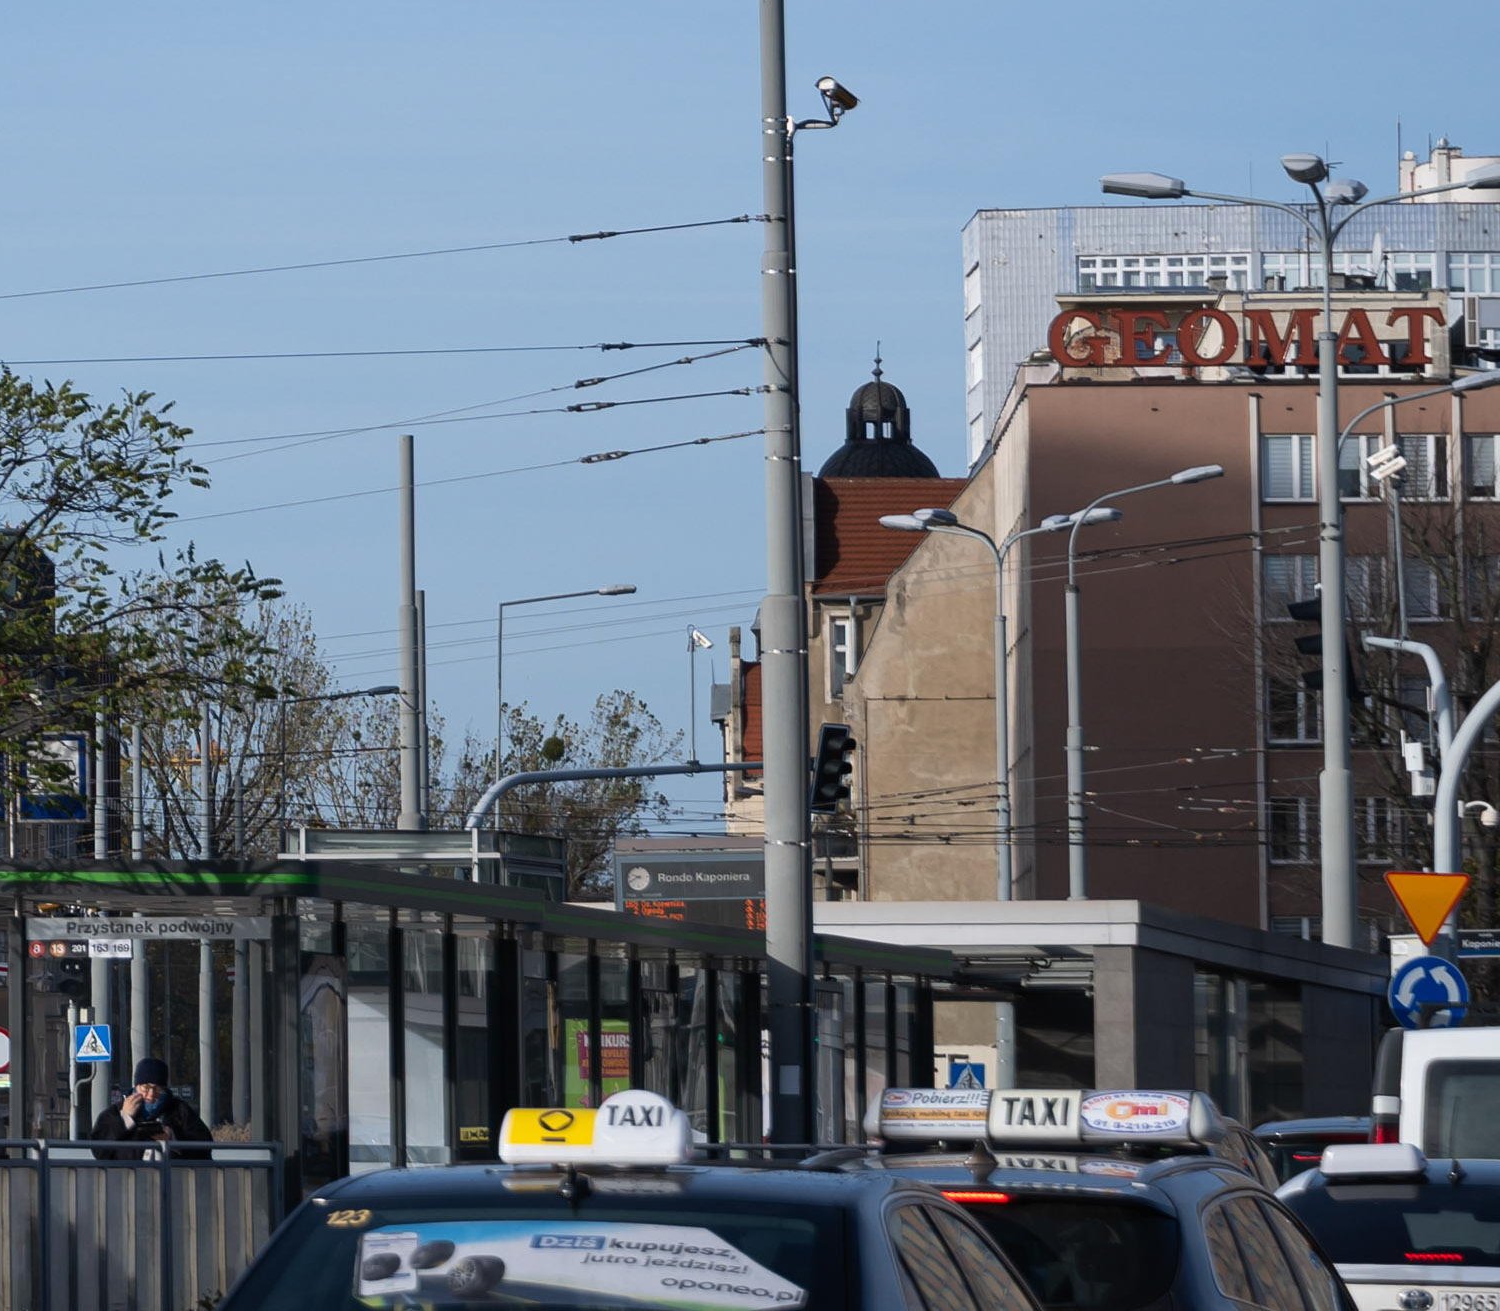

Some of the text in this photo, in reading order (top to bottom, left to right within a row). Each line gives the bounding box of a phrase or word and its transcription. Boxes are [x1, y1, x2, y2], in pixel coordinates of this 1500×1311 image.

[1047, 307, 1447, 369] GEOMAT
[657, 872, 750, 884] Rondo Kaponiera
[66, 920, 234, 936] Przystanek podwójny
[33, 943, 130, 954] 8 13 201 163 169
[912, 1092, 979, 1104] Pobierz!!!
[605, 1103, 664, 1129] TAXI
[1002, 1096, 1071, 1127] TAXI
[326, 1209, 372, 1229] 123
[539, 1234, 738, 1262] Dziś kupujesz,
[581, 1250, 750, 1276] jutro jeździsz!
[660, 1275, 808, 1305] oponeo.pl
